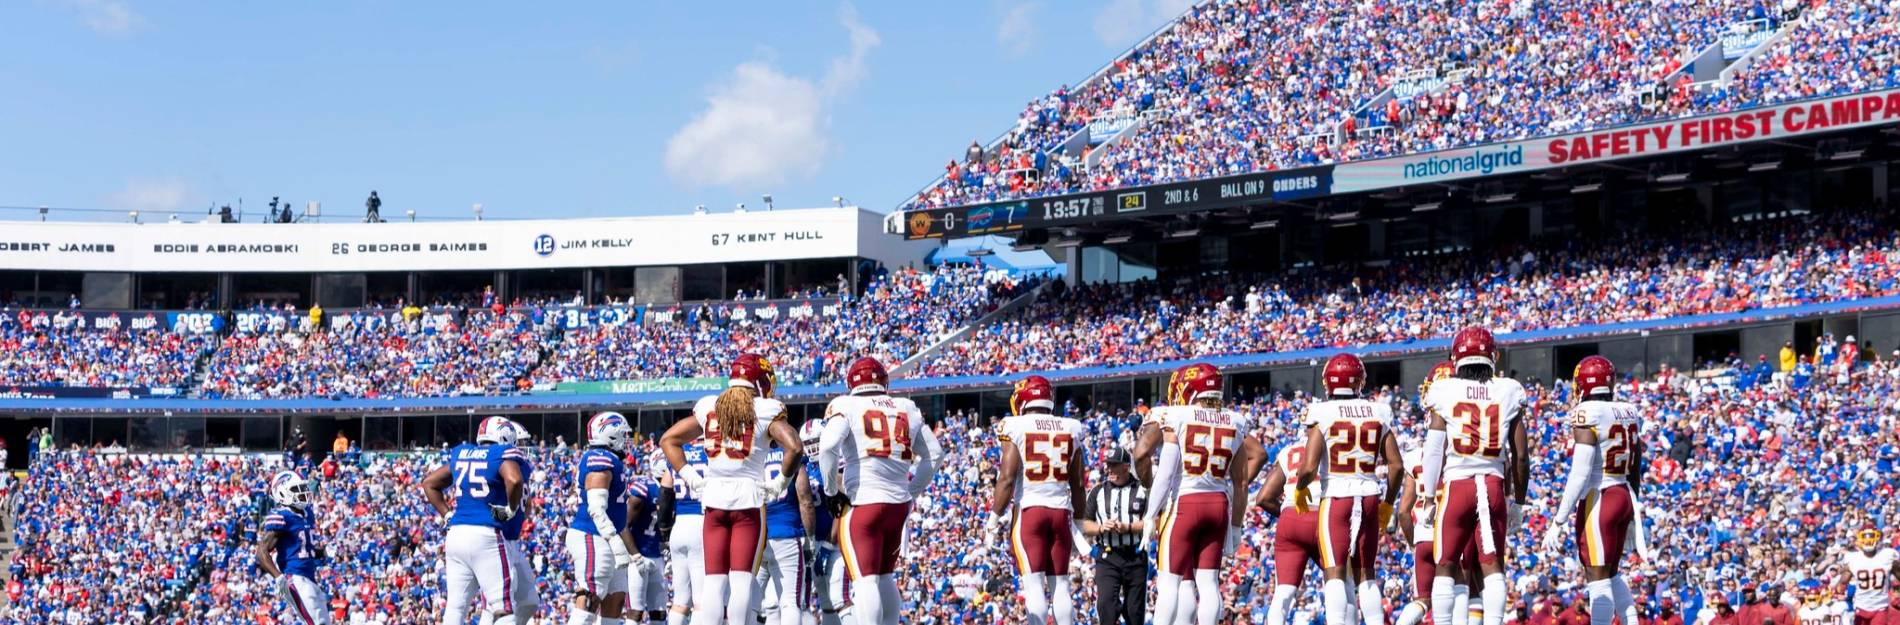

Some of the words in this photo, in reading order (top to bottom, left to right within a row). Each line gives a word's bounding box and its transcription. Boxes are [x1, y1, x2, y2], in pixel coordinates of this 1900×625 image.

[1548, 125, 1674, 164] SAFETY
[1681, 110, 1776, 147] FIRST
[1404, 145, 1522, 179] nationalgrid
[1164, 190, 1183, 205] 2ND
[1184, 189, 1191, 202] &
[1192, 188, 1199, 201] 6
[1220, 183, 1242, 198] BALL
[1244, 181, 1258, 195] ON
[1258, 180, 1265, 193] 9
[1043, 198, 1090, 220] 13:57
[1125, 195, 1139, 208] 24
[944, 212, 954, 230] 0
[1006, 206, 1015, 224] 7
[535, 236, 553, 253] 12
[561, 239, 587, 249] JIM
[592, 238, 633, 248] KELLY
[711, 233, 729, 246] 67
[737, 232, 776, 243] KENT
[784, 230, 823, 241] HULL
[58, 243, 115, 253] JAMES
[154, 244, 199, 253] EDDIE
[206, 244, 299, 253] ABRAMOSKI
[332, 243, 349, 255] 26
[357, 243, 421, 253] GEORGE
[429, 242, 488, 252] SAIMES
[612, 382, 647, 394] M&T
[648, 379, 687, 393] Family
[1466, 386, 1491, 401] CURL
[1194, 409, 1231, 425] HOLCOMB
[1339, 405, 1374, 418] FULLER
[1035, 419, 1064, 431] BOSTIC
[1452, 402, 1502, 457] 31
[863, 409, 913, 460] 94
[1183, 424, 1237, 478] 55
[1329, 420, 1383, 474] 29
[763, 450, 784, 462] ANO
[1024, 432, 1074, 482] 53
[454, 461, 490, 498] 75
[1857, 568, 1886, 590] 90
